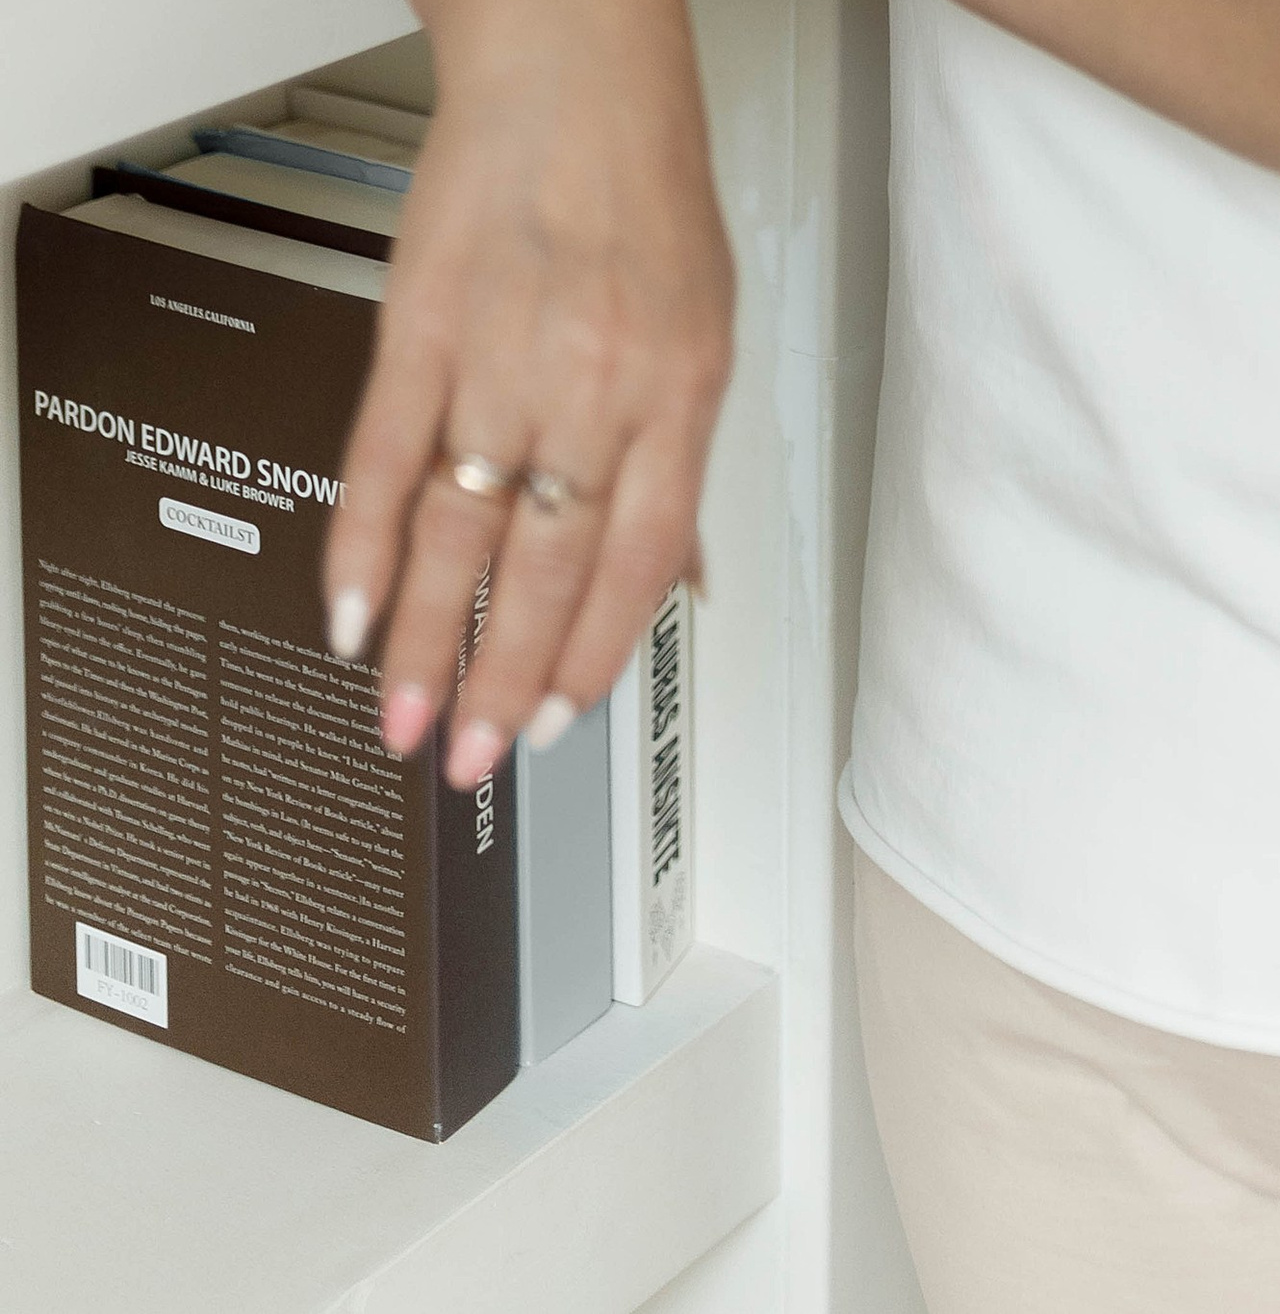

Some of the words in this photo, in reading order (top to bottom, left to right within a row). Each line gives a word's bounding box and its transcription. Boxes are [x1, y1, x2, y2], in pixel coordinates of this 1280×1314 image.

[149, 293, 167, 309] LOS
[34, 390, 136, 446] PARDON
[140, 423, 251, 480] EDWARD
[124, 449, 158, 473] JESSE
[159, 460, 198, 485] KAMM
[199, 473, 209, 487] &
[210, 476, 241, 497] LUKE
[242, 484, 295, 513] BROWER
[166, 506, 255, 545] COCKTAILST
